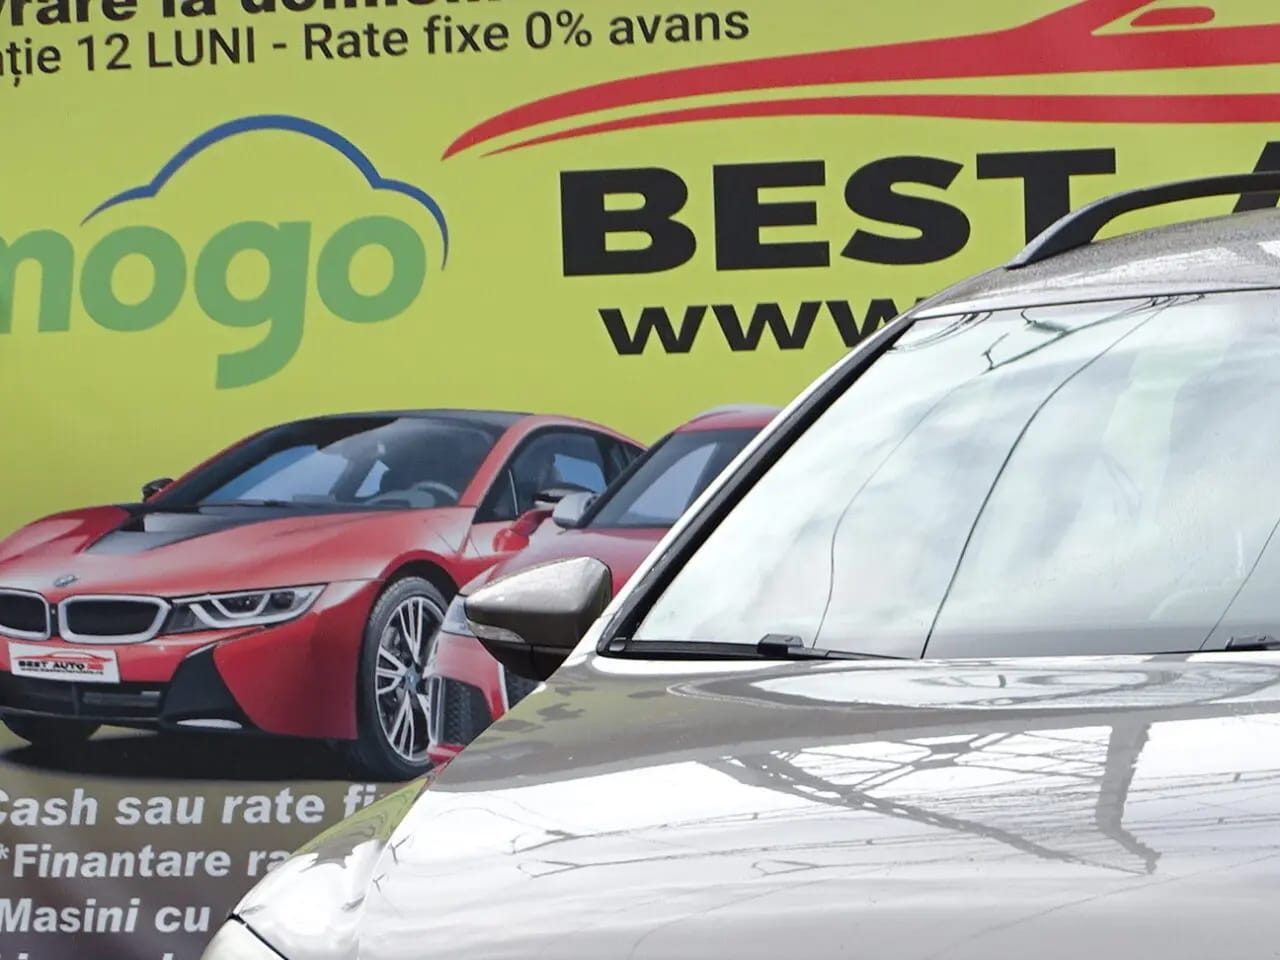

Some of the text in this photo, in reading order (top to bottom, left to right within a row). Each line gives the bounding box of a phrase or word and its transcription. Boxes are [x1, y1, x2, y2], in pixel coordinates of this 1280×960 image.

[0, 0, 137, 26] rare
[0, 37, 61, 88] ție
[77, 34, 131, 71] 12
[148, 26, 255, 68] LUNI
[304, 22, 408, 60] Rate
[423, 15, 509, 54] fixe
[525, 10, 593, 50] 0%
[609, 10, 750, 45] avans
[560, 149, 1115, 277] BEST
[115, 796, 205, 825] sau
[221, 787, 325, 824] rate
[343, 784, 386, 819] fi
[0, 898, 211, 934] Masini cu
